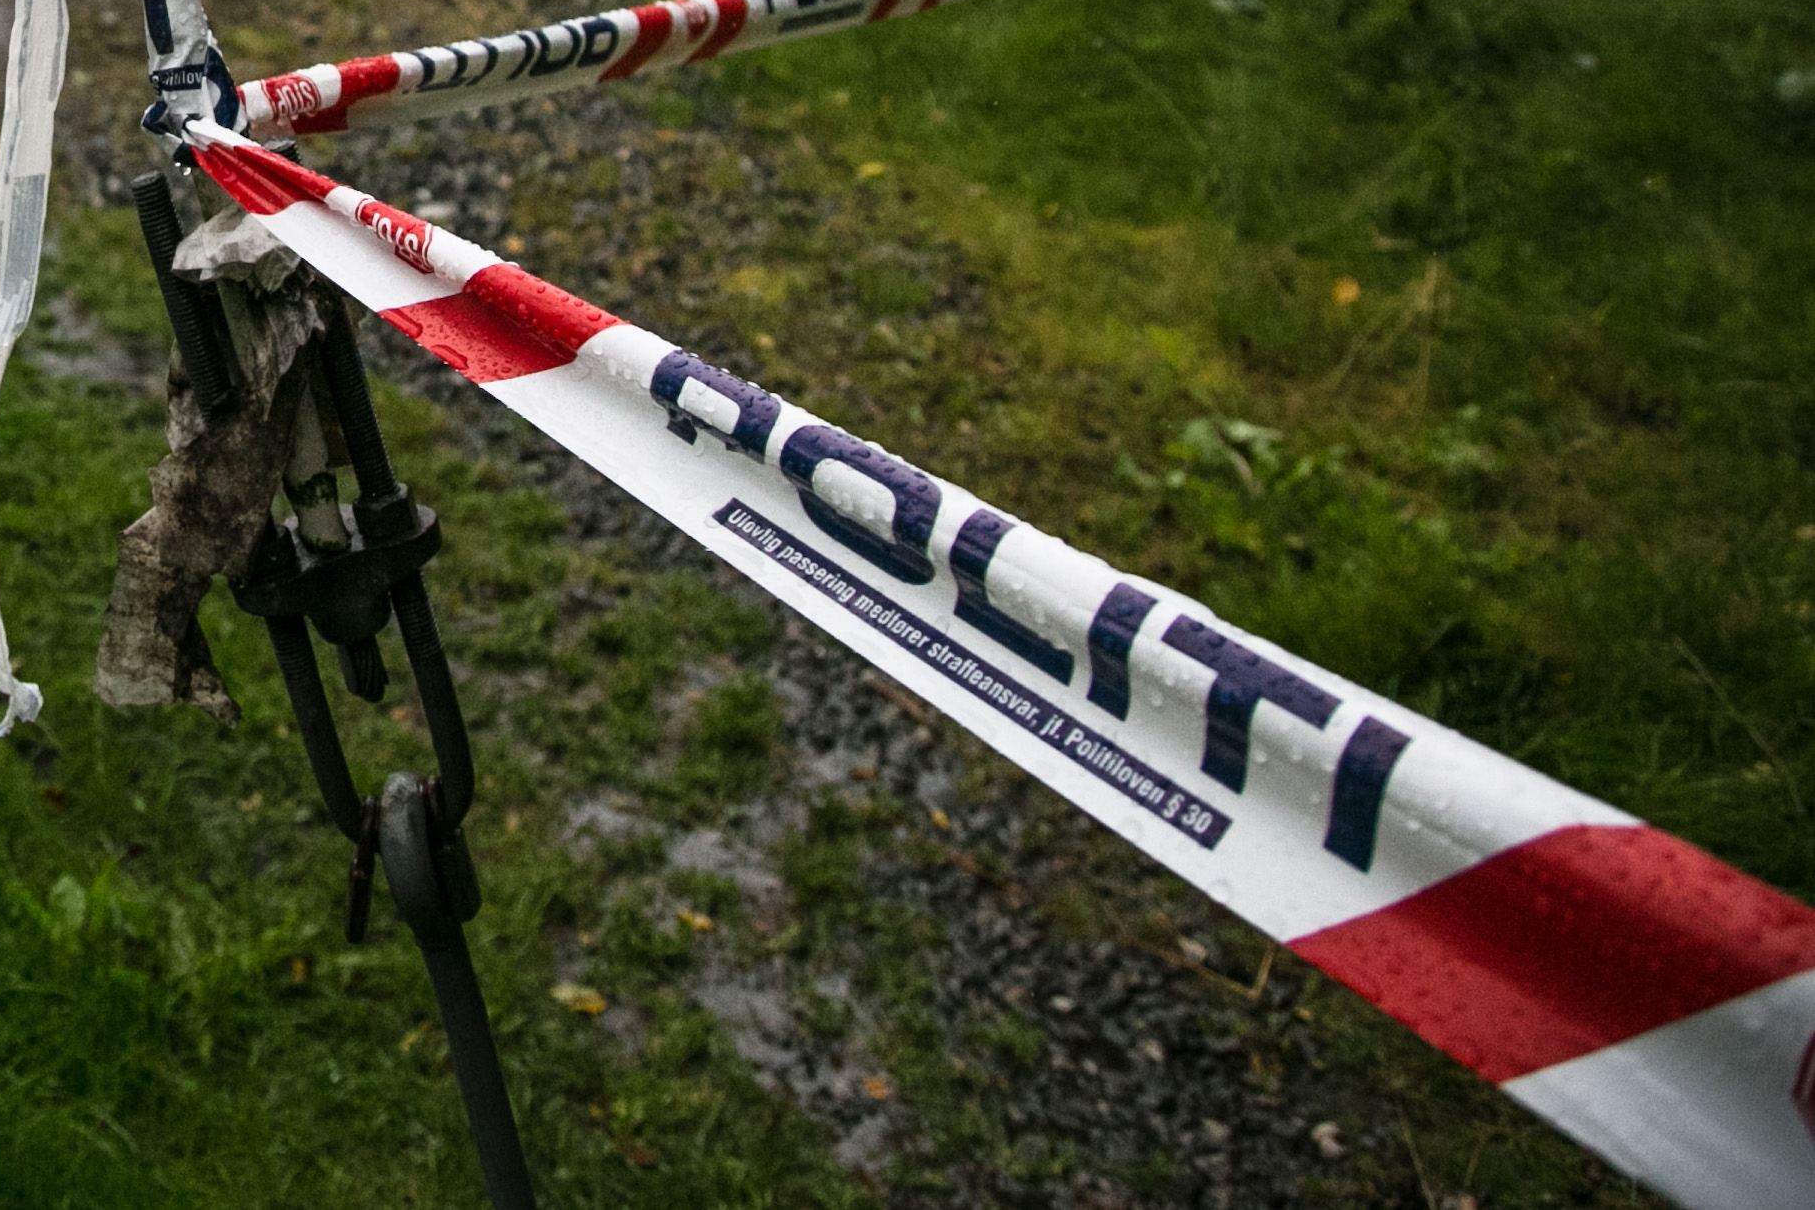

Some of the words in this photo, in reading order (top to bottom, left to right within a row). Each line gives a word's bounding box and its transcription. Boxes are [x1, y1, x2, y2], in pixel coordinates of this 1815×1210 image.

[276, 80, 316, 117] STOP
[651, 349, 1410, 871] POLITI
[728, 508, 783, 552] Ulovlig
[776, 543, 857, 604] passering
[854, 593, 930, 650] medfører
[927, 636, 1041, 727] straffeansvar,
[1039, 713, 1061, 739] jf.
[1064, 727, 1164, 805] Politiloven
[1161, 792, 1180, 819] §
[1181, 804, 1213, 834] 30
